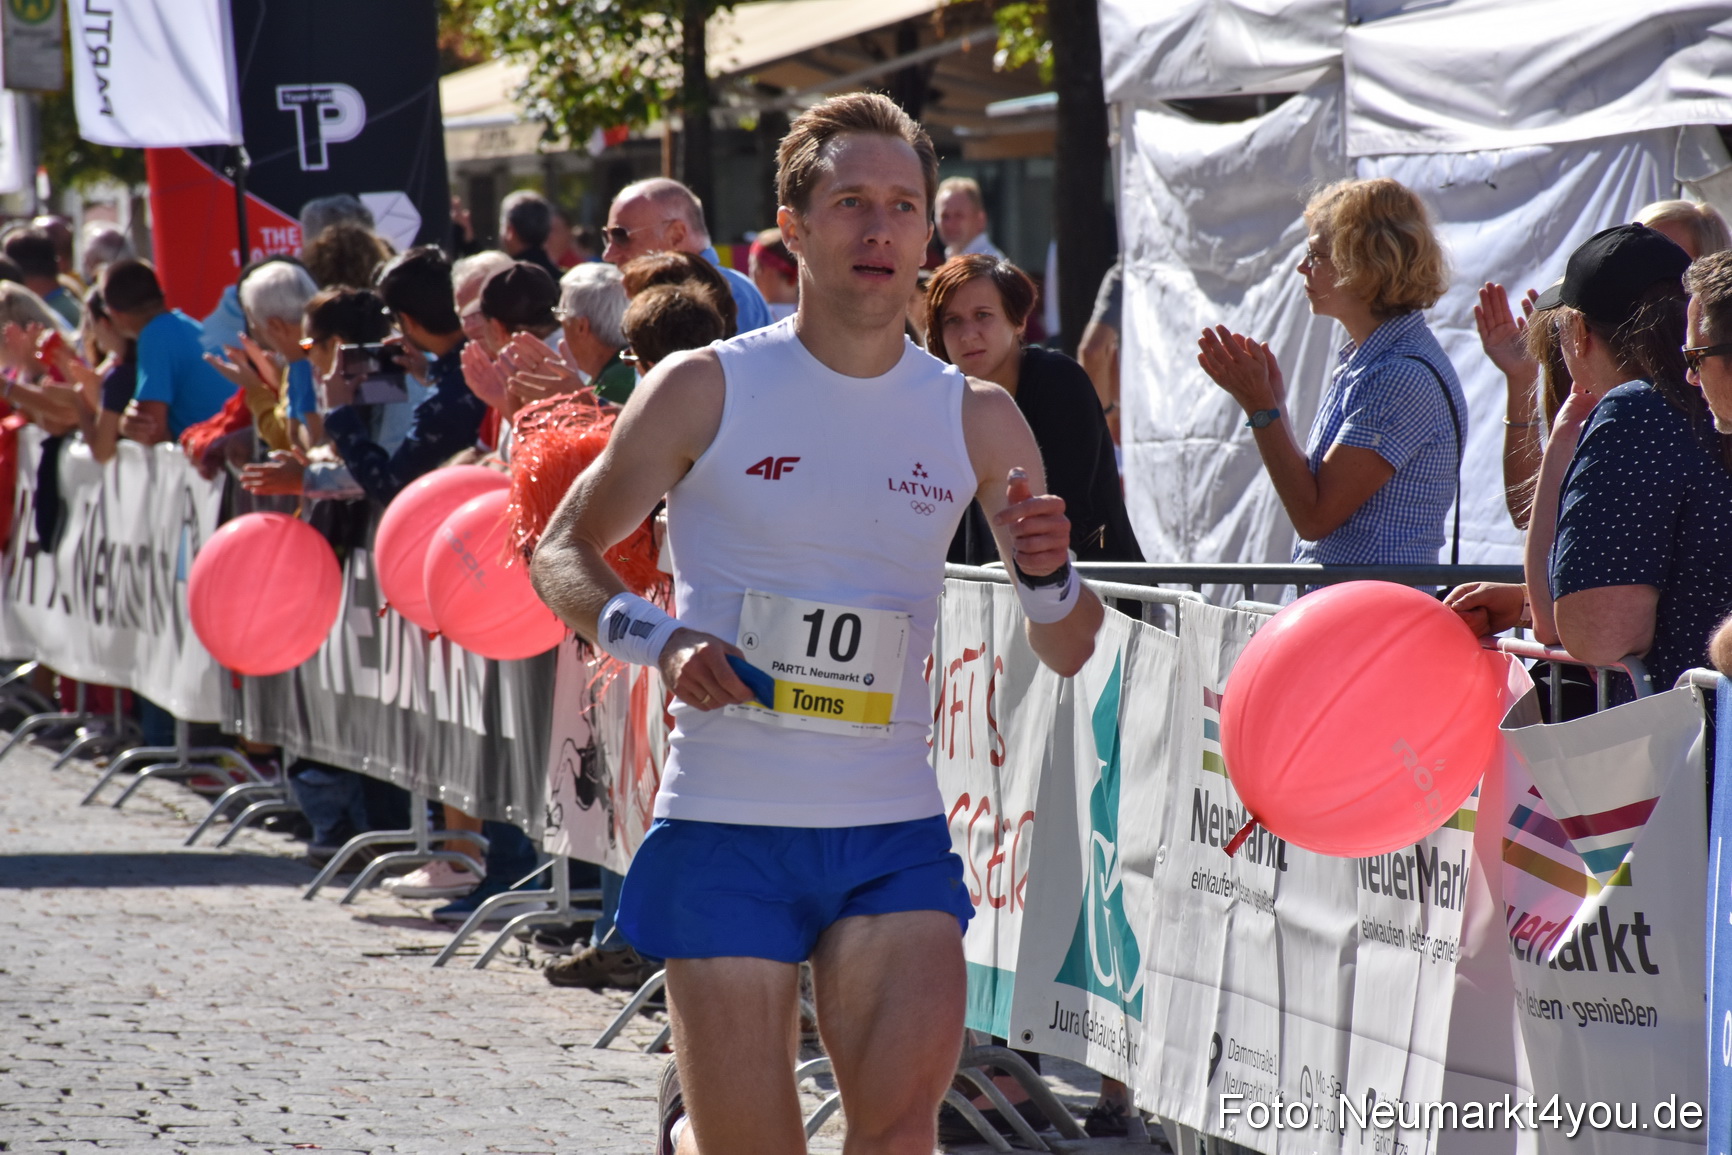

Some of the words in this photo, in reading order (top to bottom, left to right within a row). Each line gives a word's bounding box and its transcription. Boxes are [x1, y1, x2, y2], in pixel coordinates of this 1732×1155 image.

[260, 226, 299, 247] THE
[888, 477, 954, 503] LATVIJA
[803, 608, 862, 663] 10
[772, 660, 807, 676] PARTL
[809, 667, 860, 684] Neumarkt
[792, 688, 845, 716] Toms
[1361, 914, 1405, 949] einkaufen
[1049, 1000, 1080, 1037] Jura
[1525, 987, 1564, 1020] leben
[1571, 996, 1658, 1028] genießen
